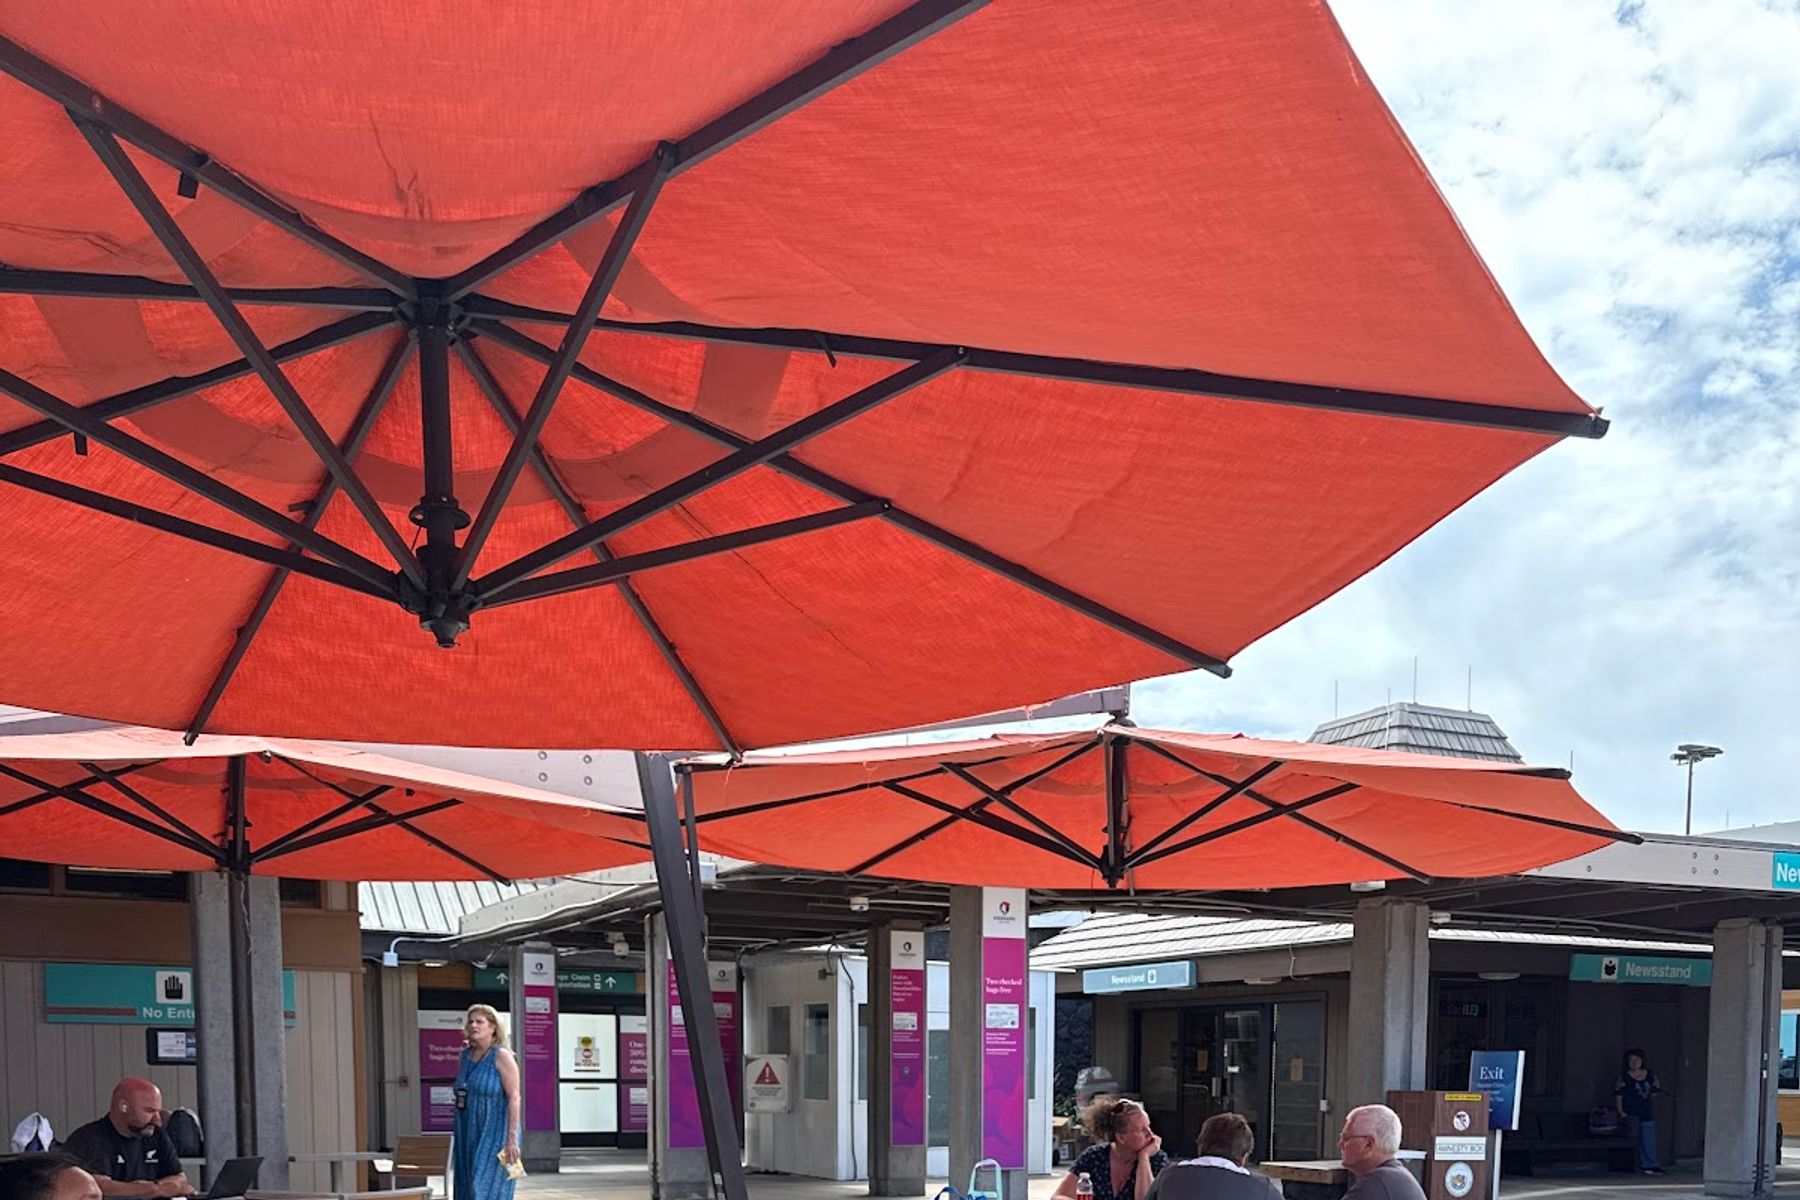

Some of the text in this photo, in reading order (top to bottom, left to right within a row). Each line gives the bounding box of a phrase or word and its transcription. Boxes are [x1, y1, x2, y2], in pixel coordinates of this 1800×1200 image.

[1625, 962, 1692, 978] Newsstand
[143, 1007, 163, 1018] No
[1480, 1066, 1504, 1080] Exit
